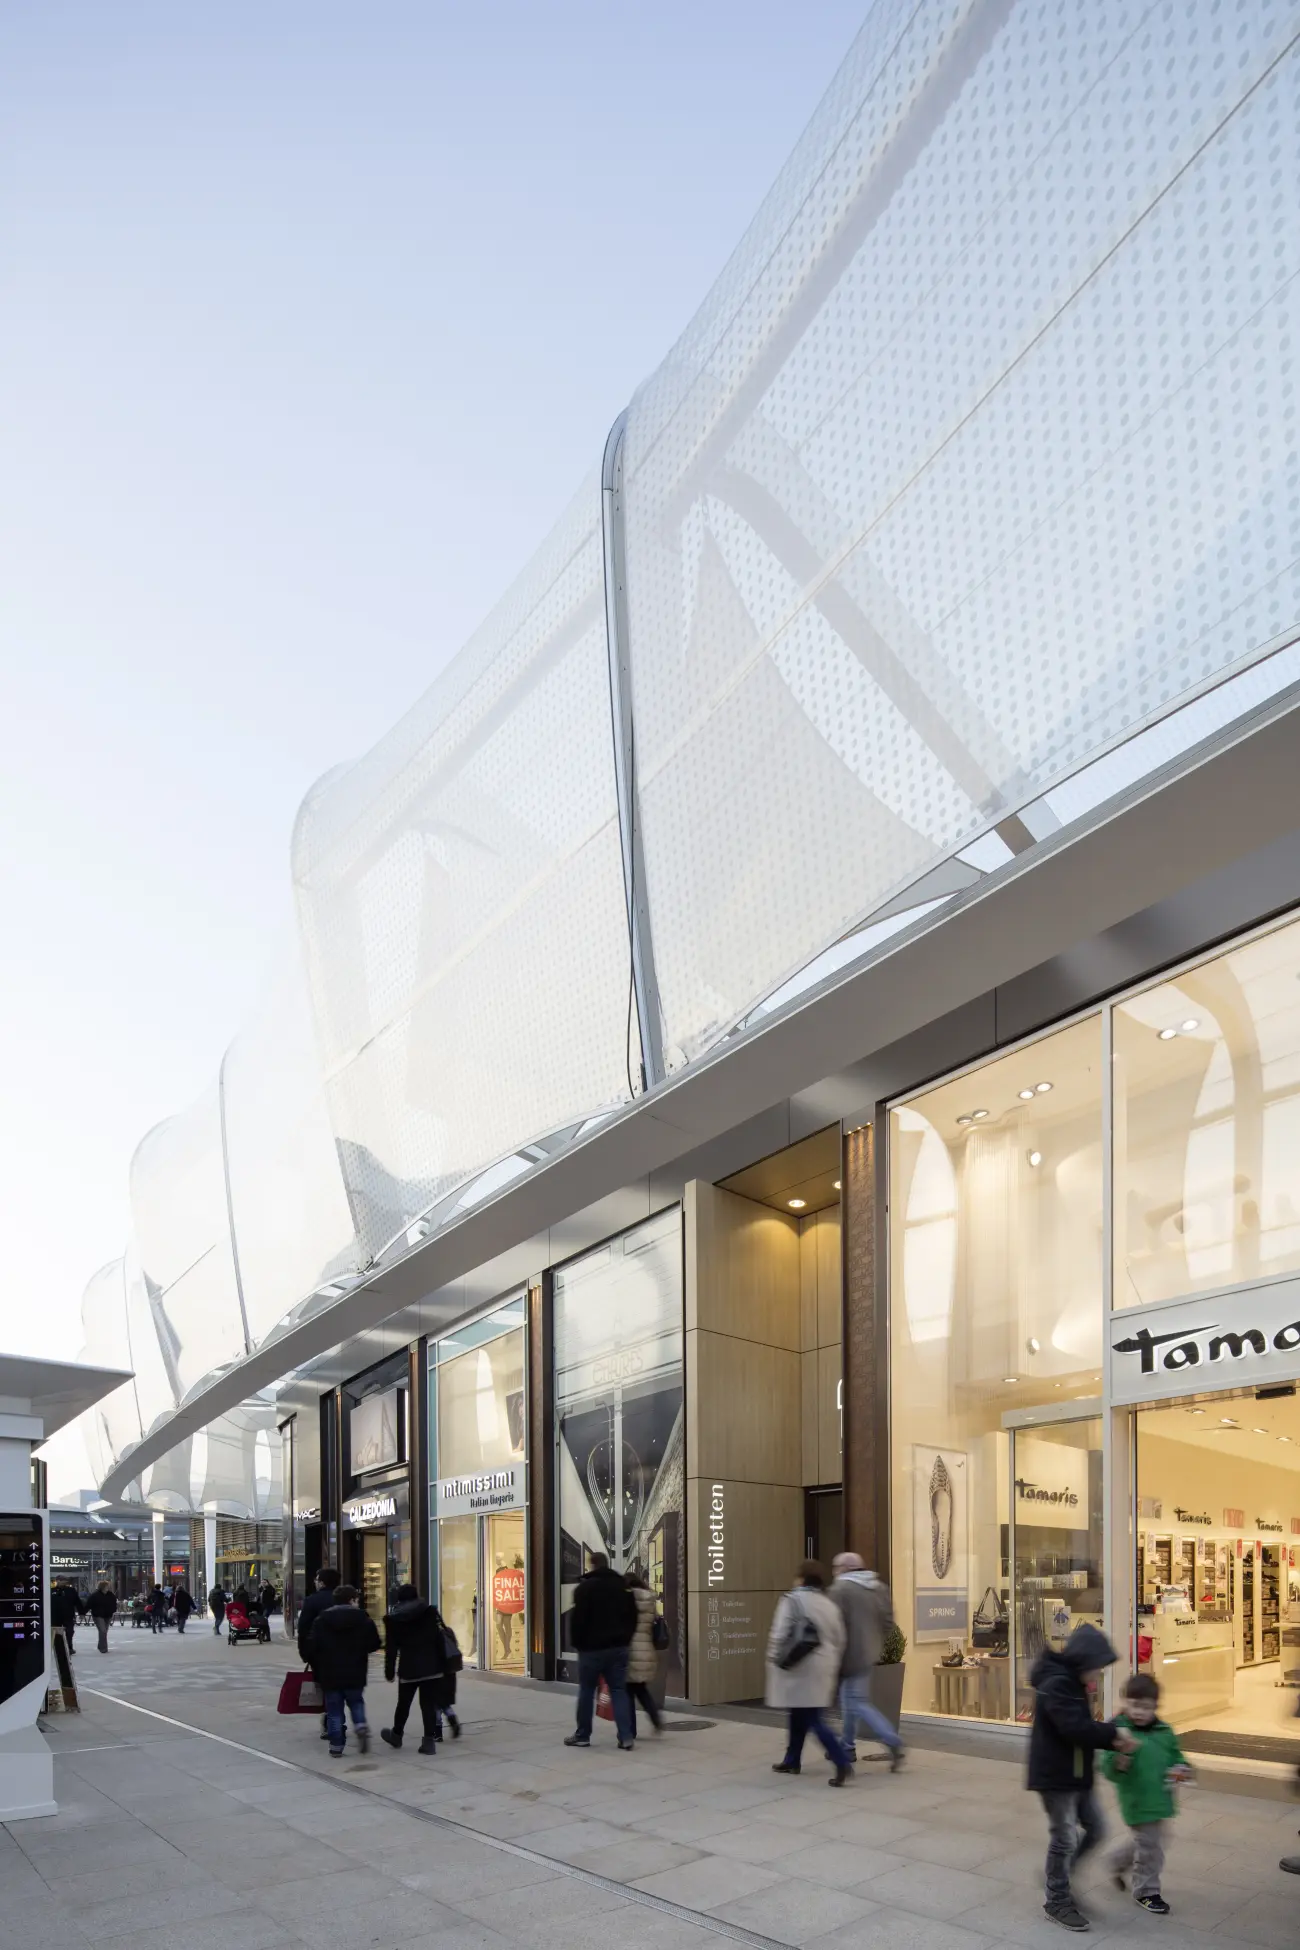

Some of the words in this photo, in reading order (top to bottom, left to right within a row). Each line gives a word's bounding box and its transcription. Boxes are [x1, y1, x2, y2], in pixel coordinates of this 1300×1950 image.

[470, 1496, 489, 1508] Italian
[489, 1491, 514, 1506] lingerie
[349, 1497, 396, 1523] CALZEDONIA
[707, 1484, 725, 1587] Toiletten
[494, 1576, 524, 1588] FINAL
[495, 1588, 524, 1602] SALE
[928, 1607, 956, 1618] SPRING
